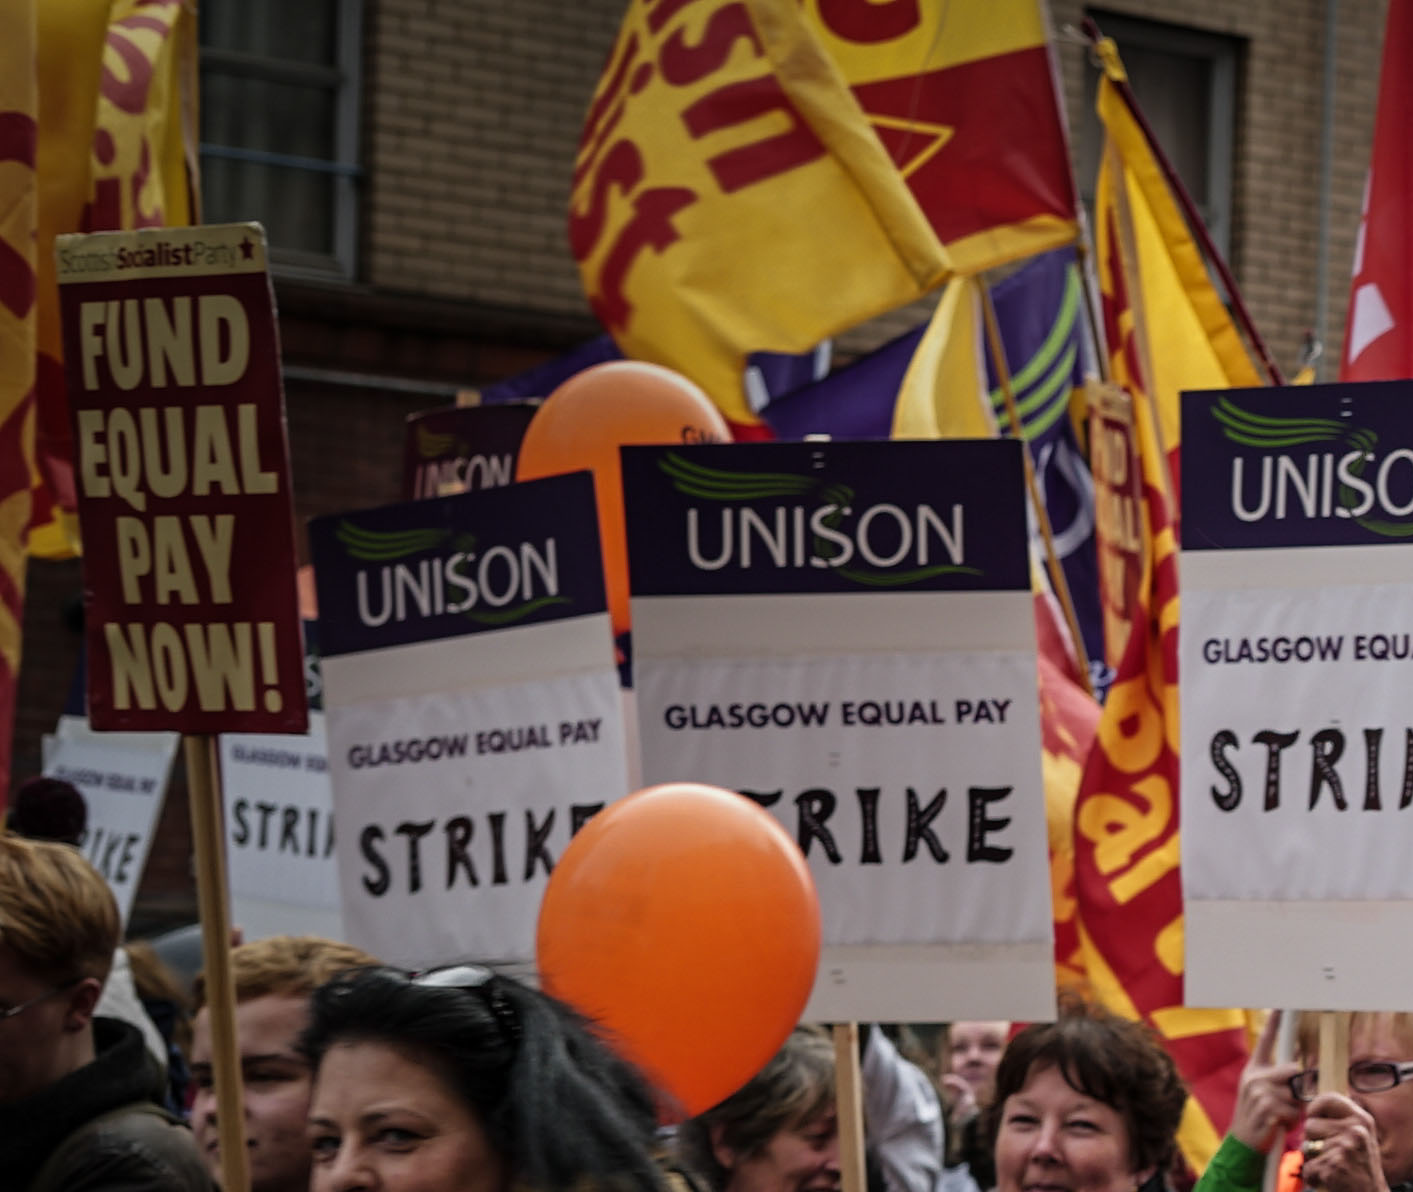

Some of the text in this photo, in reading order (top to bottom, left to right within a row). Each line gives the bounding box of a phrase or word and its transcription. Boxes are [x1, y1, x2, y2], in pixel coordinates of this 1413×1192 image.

[79, 294, 250, 391] FUND
[77, 403, 278, 511] EQUAL
[116, 514, 235, 605] PAY
[685, 503, 965, 571] UNISON
[357, 537, 559, 628] UNISON
[104, 621, 284, 714] NOW!
[1203, 635, 1342, 664] GLASGOW
[348, 735, 468, 770] GLASGOW
[476, 724, 551, 755] EQUAL
[558, 718, 602, 746] PAY
[664, 699, 1011, 730] GLASGOW EQUAL PAY
[234, 797, 336, 860] STRI
[737, 786, 1014, 865] RIKE
